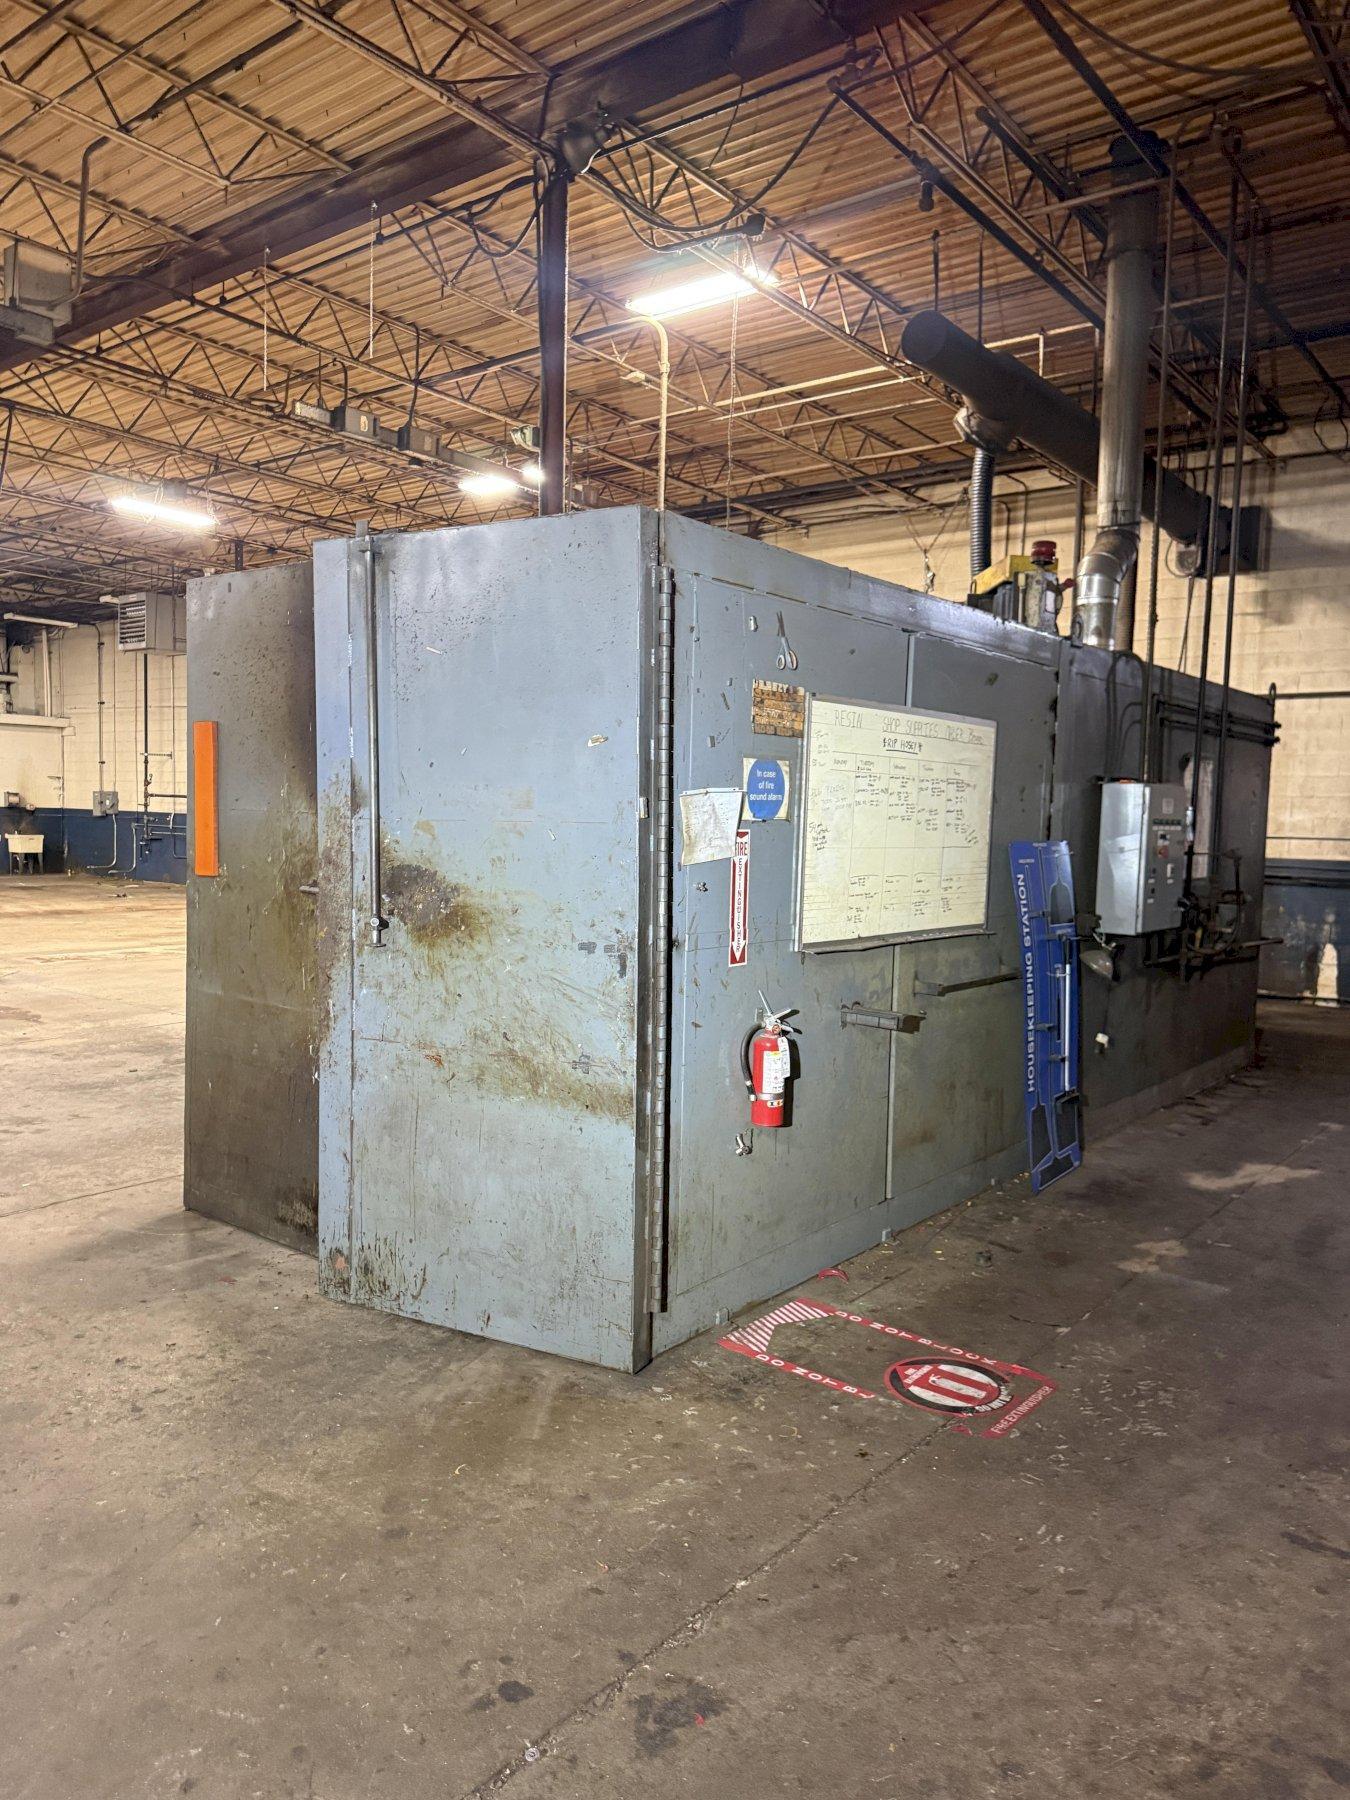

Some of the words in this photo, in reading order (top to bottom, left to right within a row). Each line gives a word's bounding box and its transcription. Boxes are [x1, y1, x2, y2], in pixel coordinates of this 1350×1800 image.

[833, 709, 863, 728] RESIN
[887, 738, 898, 749] RIP
[756, 769, 763, 777] In
[763, 770, 777, 778] case
[758, 781, 765, 789] of
[765, 781, 775, 789] fire
[750, 793, 767, 801] sound
[767, 793, 783, 801] alarm
[735, 841, 748, 856] FIRE
[1017, 874, 1032, 947] STATION
[1023, 953, 1034, 1093] HOUSEKEEPING
[835, 1311, 862, 1322] DO
[869, 1321, 912, 1338] NOT
[917, 1338, 998, 1365] BLOCK
[756, 1354, 785, 1366] DO
[791, 1366, 838, 1386] NOT
[990, 1415, 1014, 1434] FIRE
[1007, 1386, 1054, 1422] EXTINGUISHER
